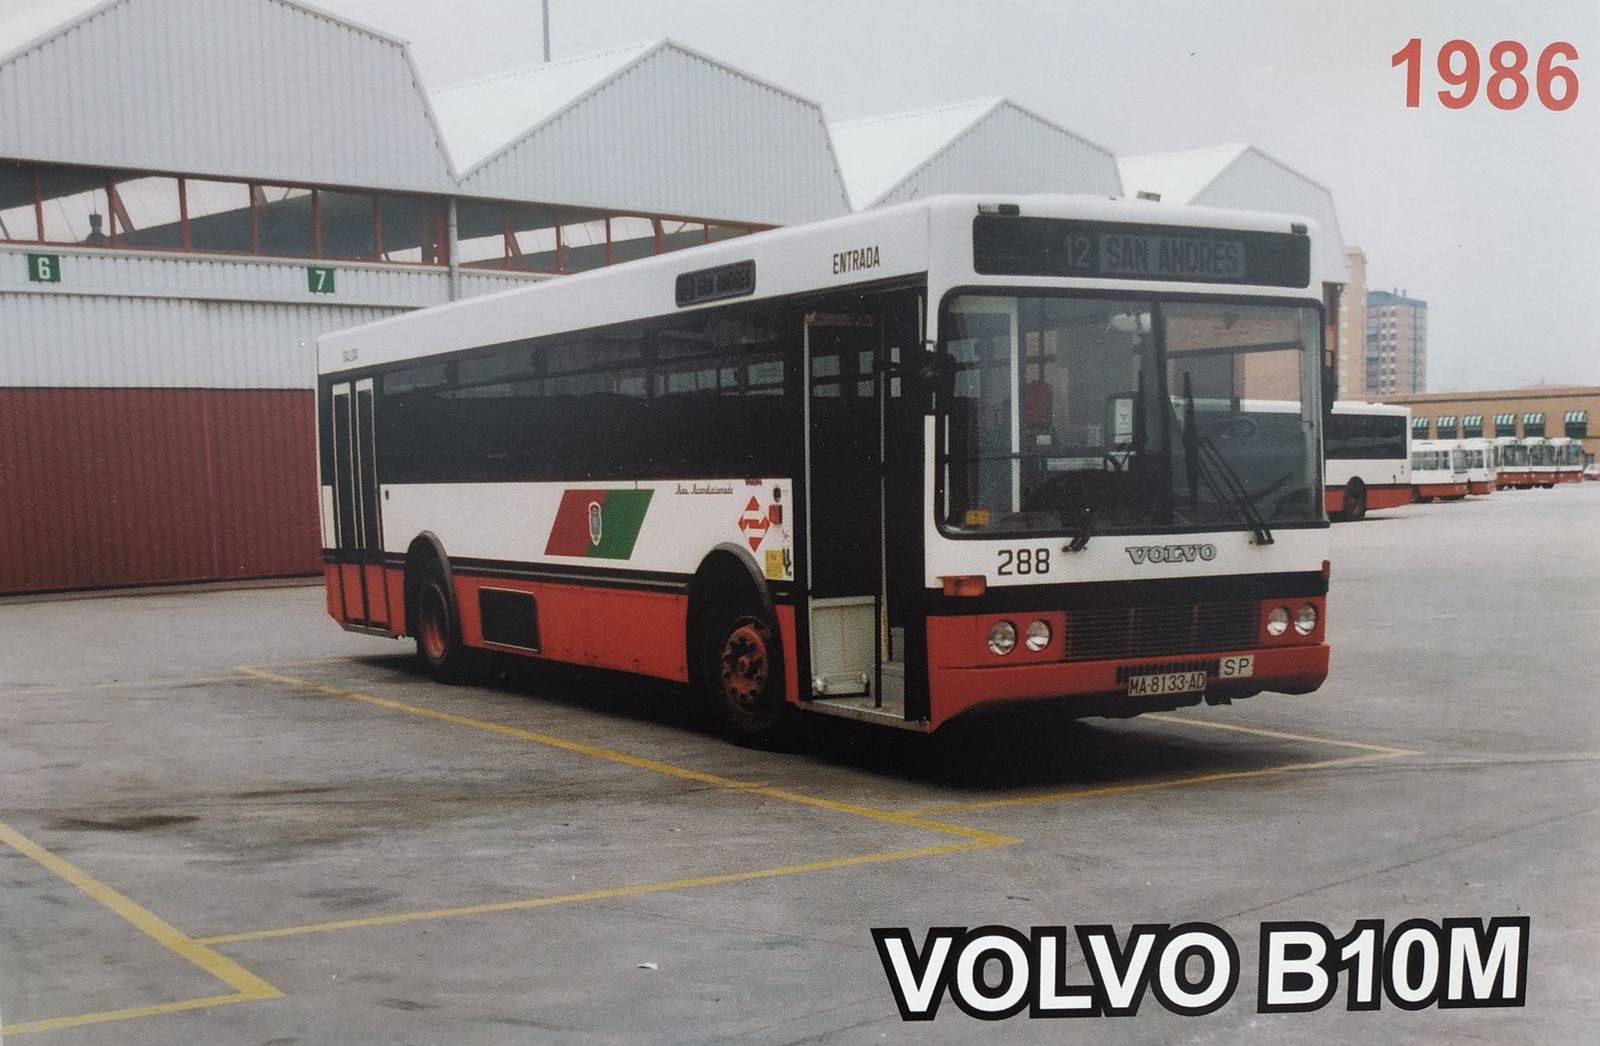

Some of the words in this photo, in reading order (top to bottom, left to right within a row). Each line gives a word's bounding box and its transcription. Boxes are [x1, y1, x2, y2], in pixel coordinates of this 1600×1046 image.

[832, 245, 881, 275] ENTRADA
[1064, 235, 1091, 269] 12
[1106, 236, 1149, 271] SAN
[1158, 239, 1239, 274] ANDRES
[37, 257, 50, 280] 6
[315, 270, 326, 290] 7
[998, 548, 1050, 576] 288
[1125, 544, 1217, 564] VOLVO
